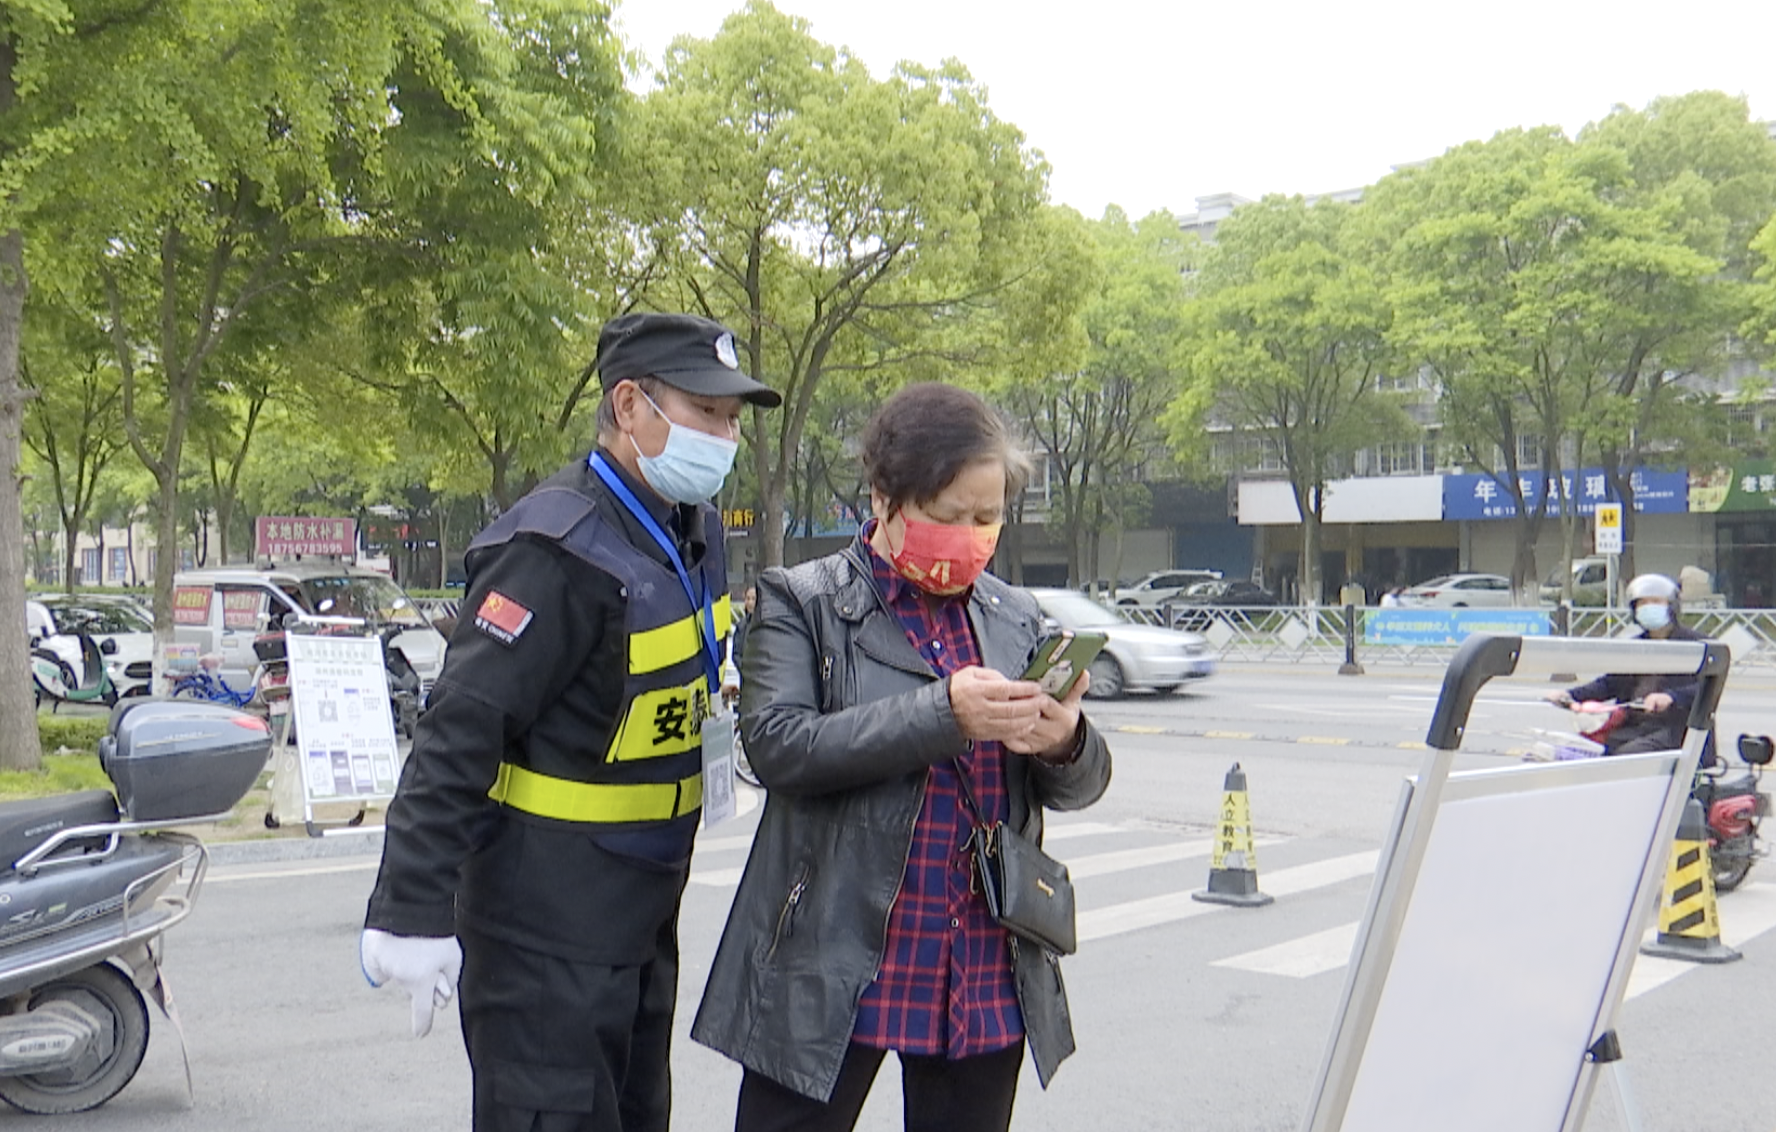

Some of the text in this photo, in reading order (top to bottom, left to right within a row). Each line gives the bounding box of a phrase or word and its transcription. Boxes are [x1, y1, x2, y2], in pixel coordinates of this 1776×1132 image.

[266, 521, 344, 540] 本地防水补漏
[268, 542, 342, 554] 18756783595
[1222, 792, 1236, 854] 人立教育
